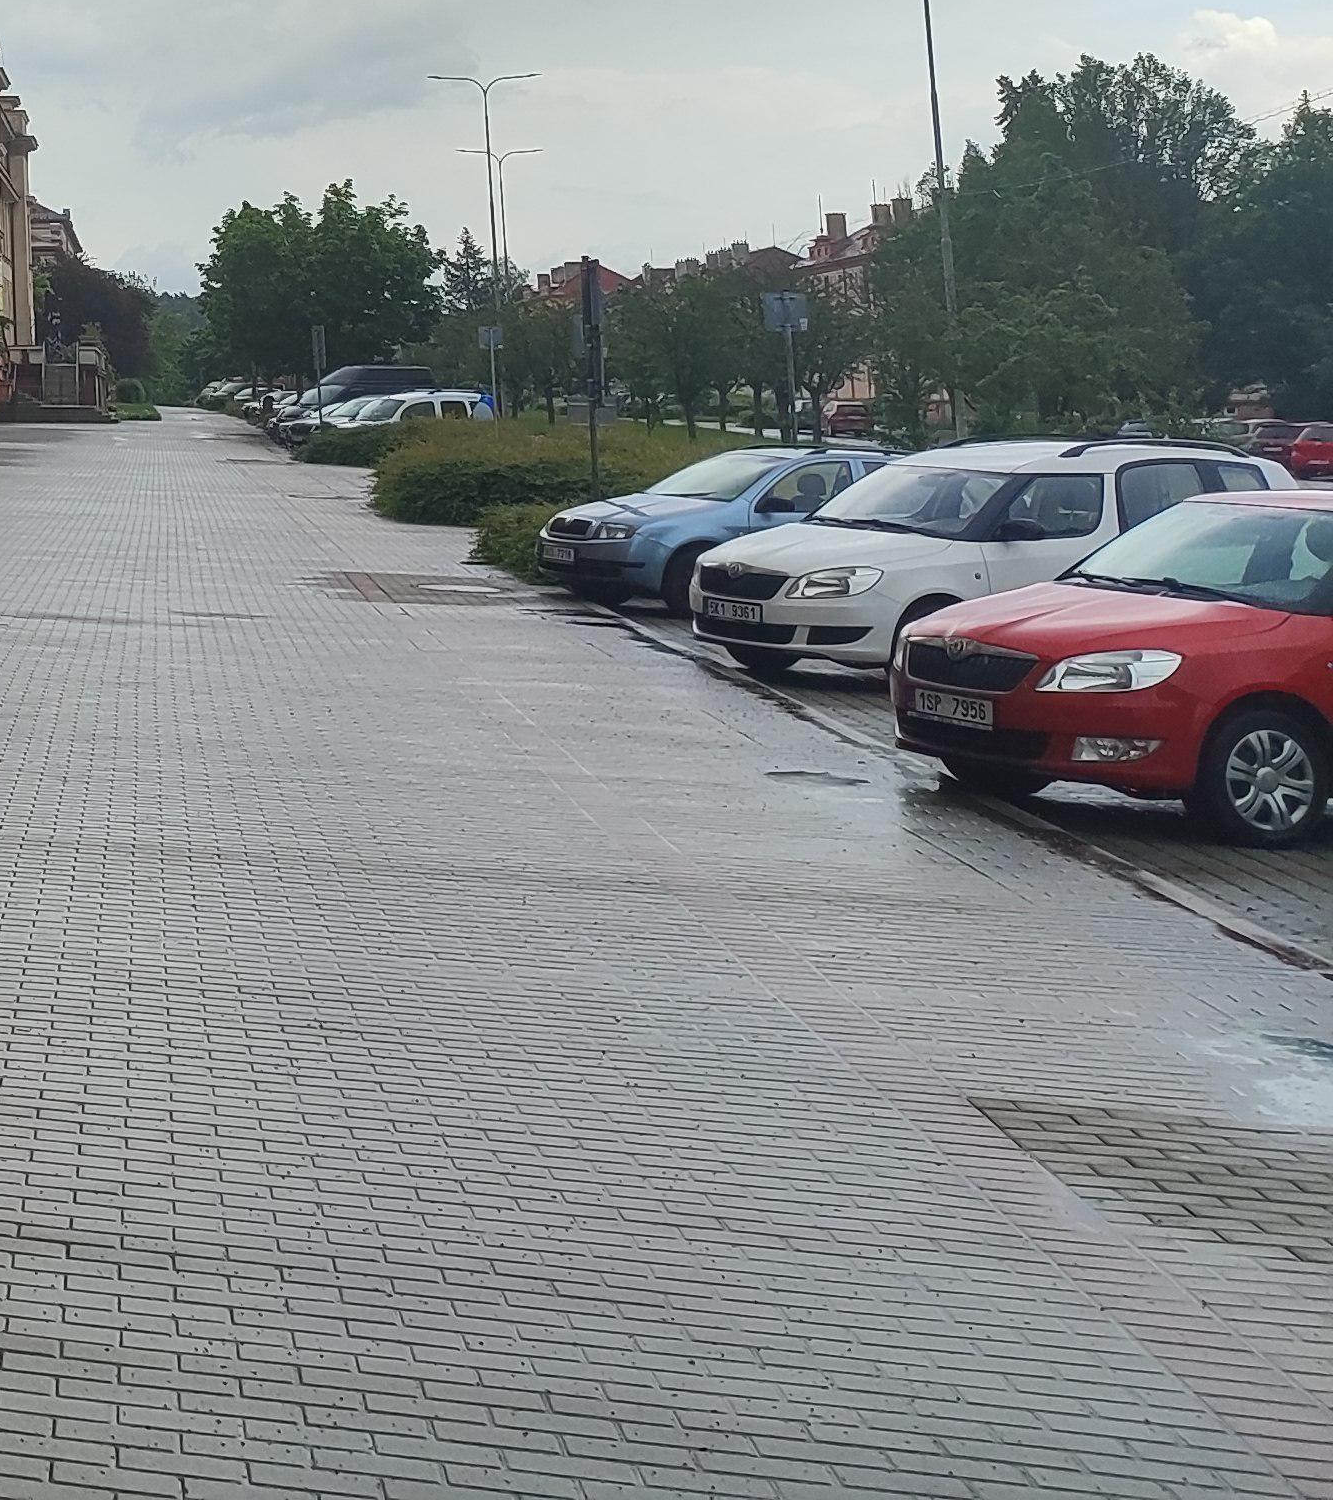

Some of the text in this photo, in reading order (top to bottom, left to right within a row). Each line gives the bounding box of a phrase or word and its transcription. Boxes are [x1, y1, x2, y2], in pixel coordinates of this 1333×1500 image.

[732, 604, 755, 620] 9361
[919, 692, 986, 720] 1SP 7956
